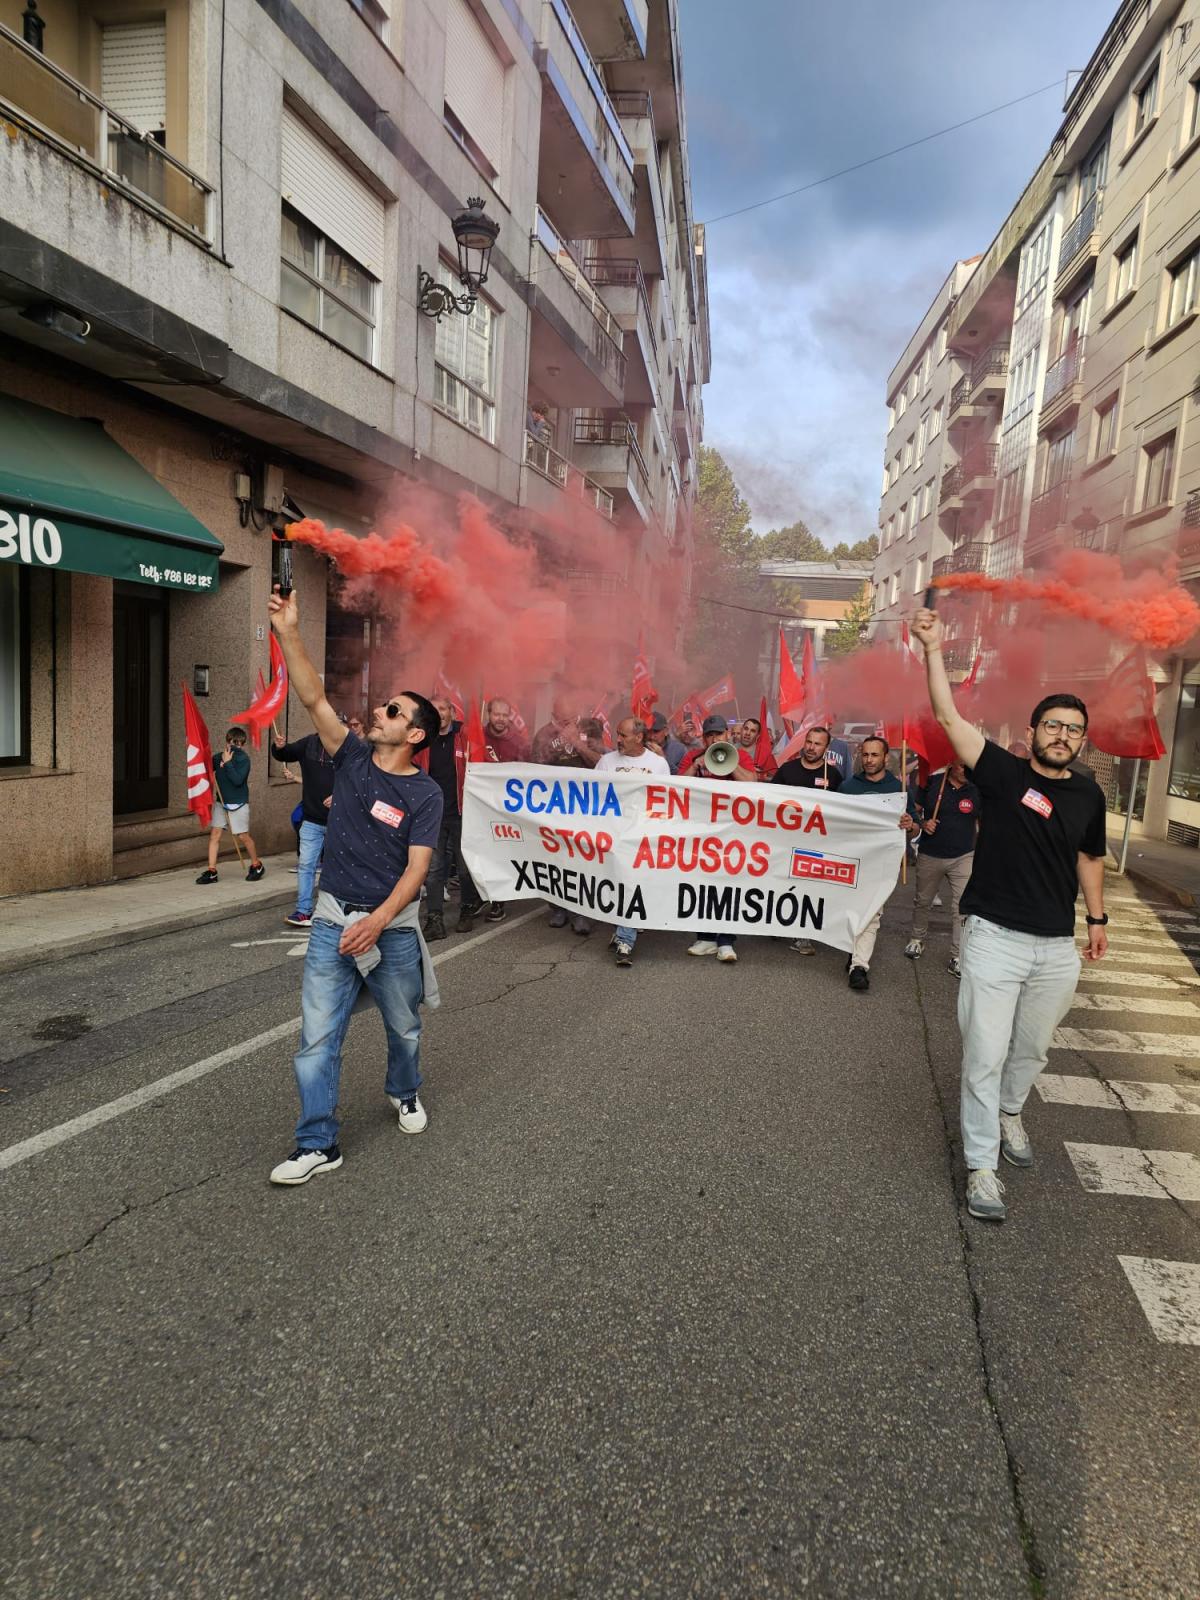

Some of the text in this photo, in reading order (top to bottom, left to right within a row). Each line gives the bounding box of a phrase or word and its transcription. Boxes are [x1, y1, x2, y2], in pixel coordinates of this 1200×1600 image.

[503, 778, 827, 836] SCANIA EN FOLGA
[539, 826, 771, 877] STOP ABUSOS
[797, 860, 850, 879] CCOO
[510, 860, 825, 931] XERENCIA DIMISIÓN
